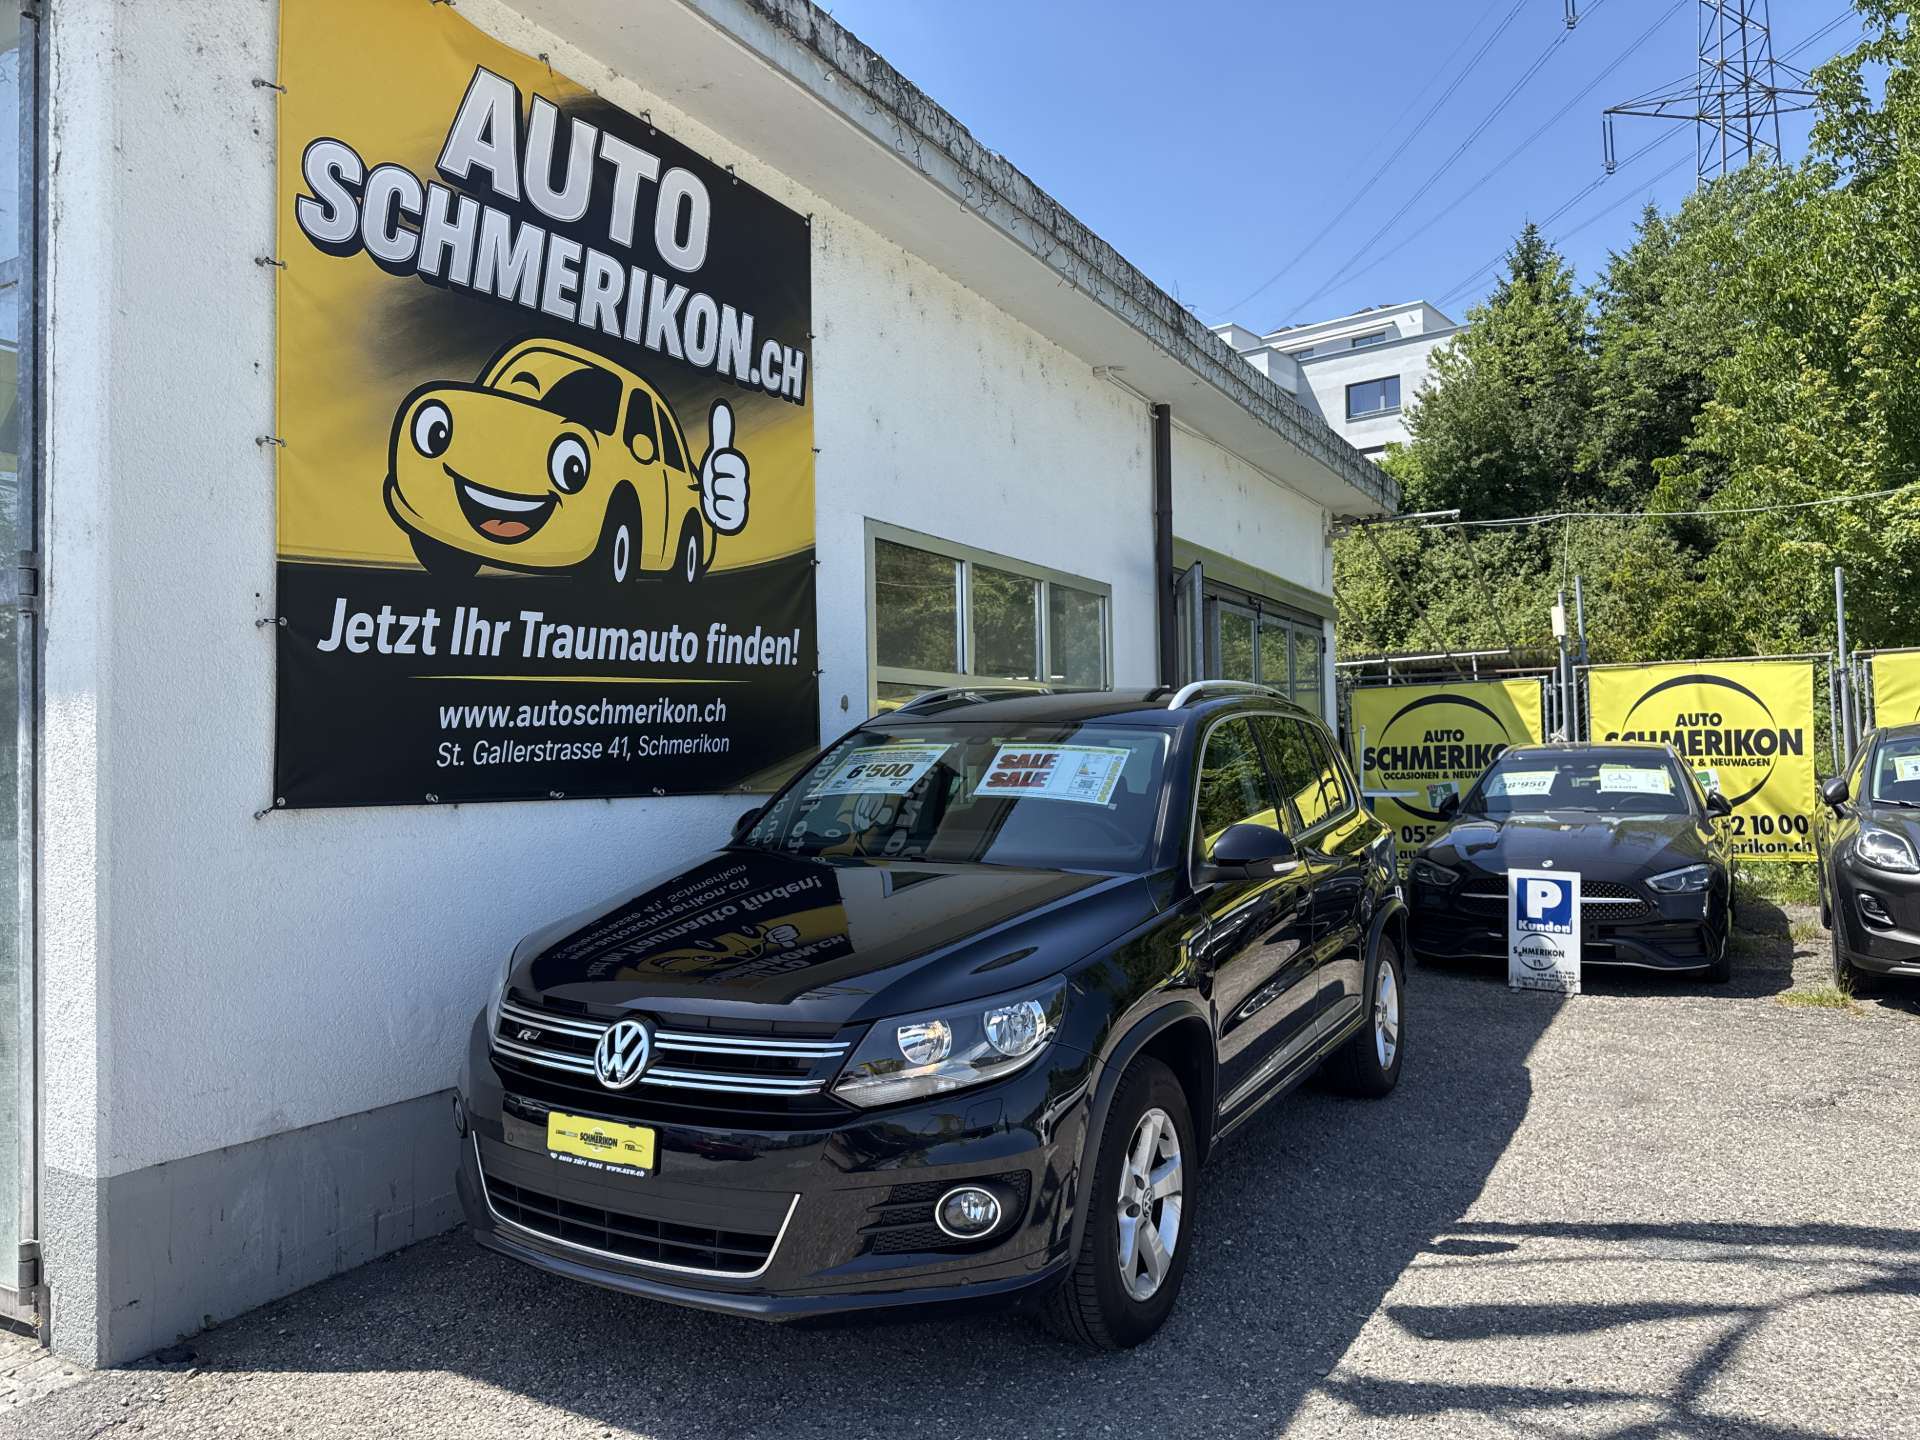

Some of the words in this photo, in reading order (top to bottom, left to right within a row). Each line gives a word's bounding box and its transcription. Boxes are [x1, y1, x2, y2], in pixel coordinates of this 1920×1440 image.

[437, 66, 711, 273] AUTO
[298, 138, 805, 402] SCHMERIKON.CH
[317, 597, 440, 656] Jetzt
[450, 606, 510, 658] Ihr
[519, 611, 699, 664] Traumauto
[706, 623, 800, 665] finden!
[439, 697, 727, 730] www.autoschmerikon.ch
[1675, 712, 1723, 727] AUTO
[1423, 729, 1465, 743] AUTO
[436, 741, 465, 768] St.
[473, 737, 602, 765] Gallerstrasse
[607, 735, 632, 761] 41,
[638, 734, 730, 758] Schmerikon
[1363, 743, 1507, 772] SCHMERIK
[997, 753, 1059, 769] SALE
[1710, 757, 1771, 767] NEUWAGEN
[846, 763, 914, 779] 6'500
[986, 771, 1050, 788] SALE
[1383, 770, 1440, 781] OCCASIONEN
[1442, 770, 1450, 779] &
[1452, 770, 1483, 780] NEUW
[1750, 814, 1775, 835] 10
[1778, 814, 1809, 835] 00
[1527, 879, 1563, 919] P
[1518, 919, 1571, 934] Kunden
[579, 1132, 618, 1148] SCHMERIKON
